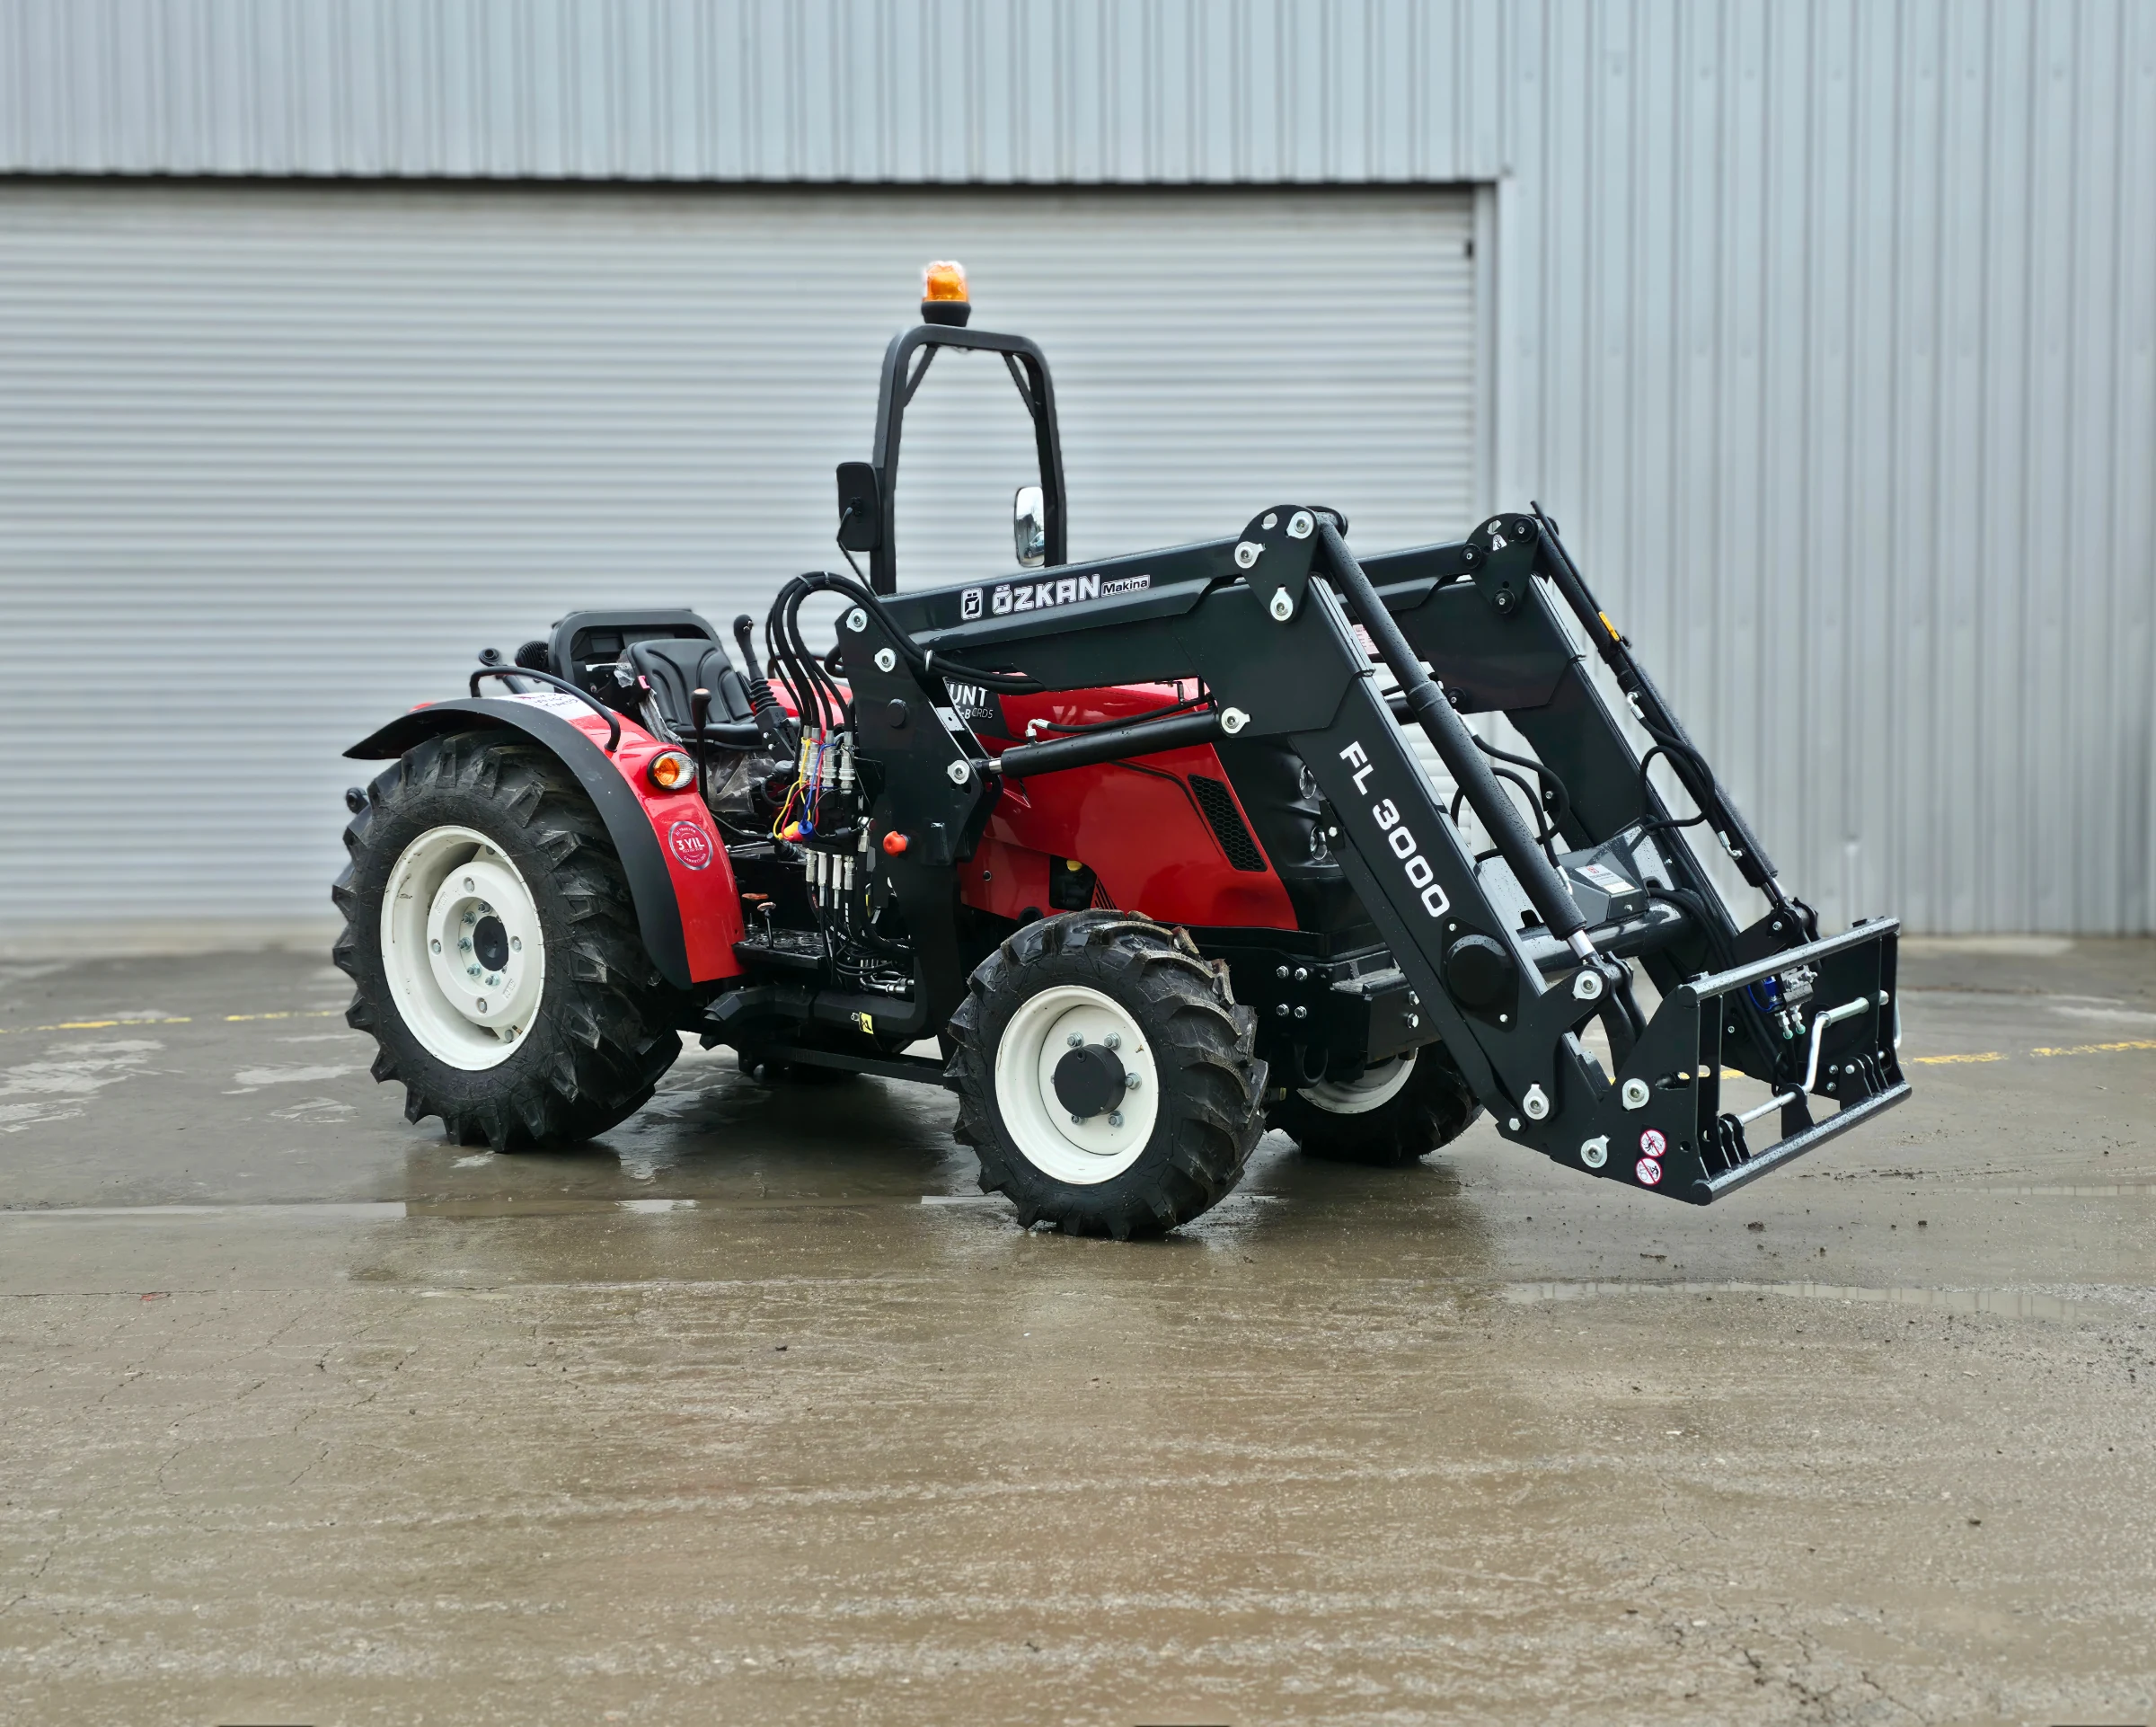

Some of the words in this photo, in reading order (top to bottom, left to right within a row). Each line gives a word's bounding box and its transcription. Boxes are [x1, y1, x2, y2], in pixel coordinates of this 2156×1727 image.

[992, 574, 1100, 615] ÖZKAN
[1102, 580, 1149, 595] Makina
[948, 683, 988, 707] UNT
[676, 839, 685, 851] 3
[684, 837, 705, 849] YIL
[1339, 740, 1374, 796] FL
[1372, 798, 1450, 917] 3000
